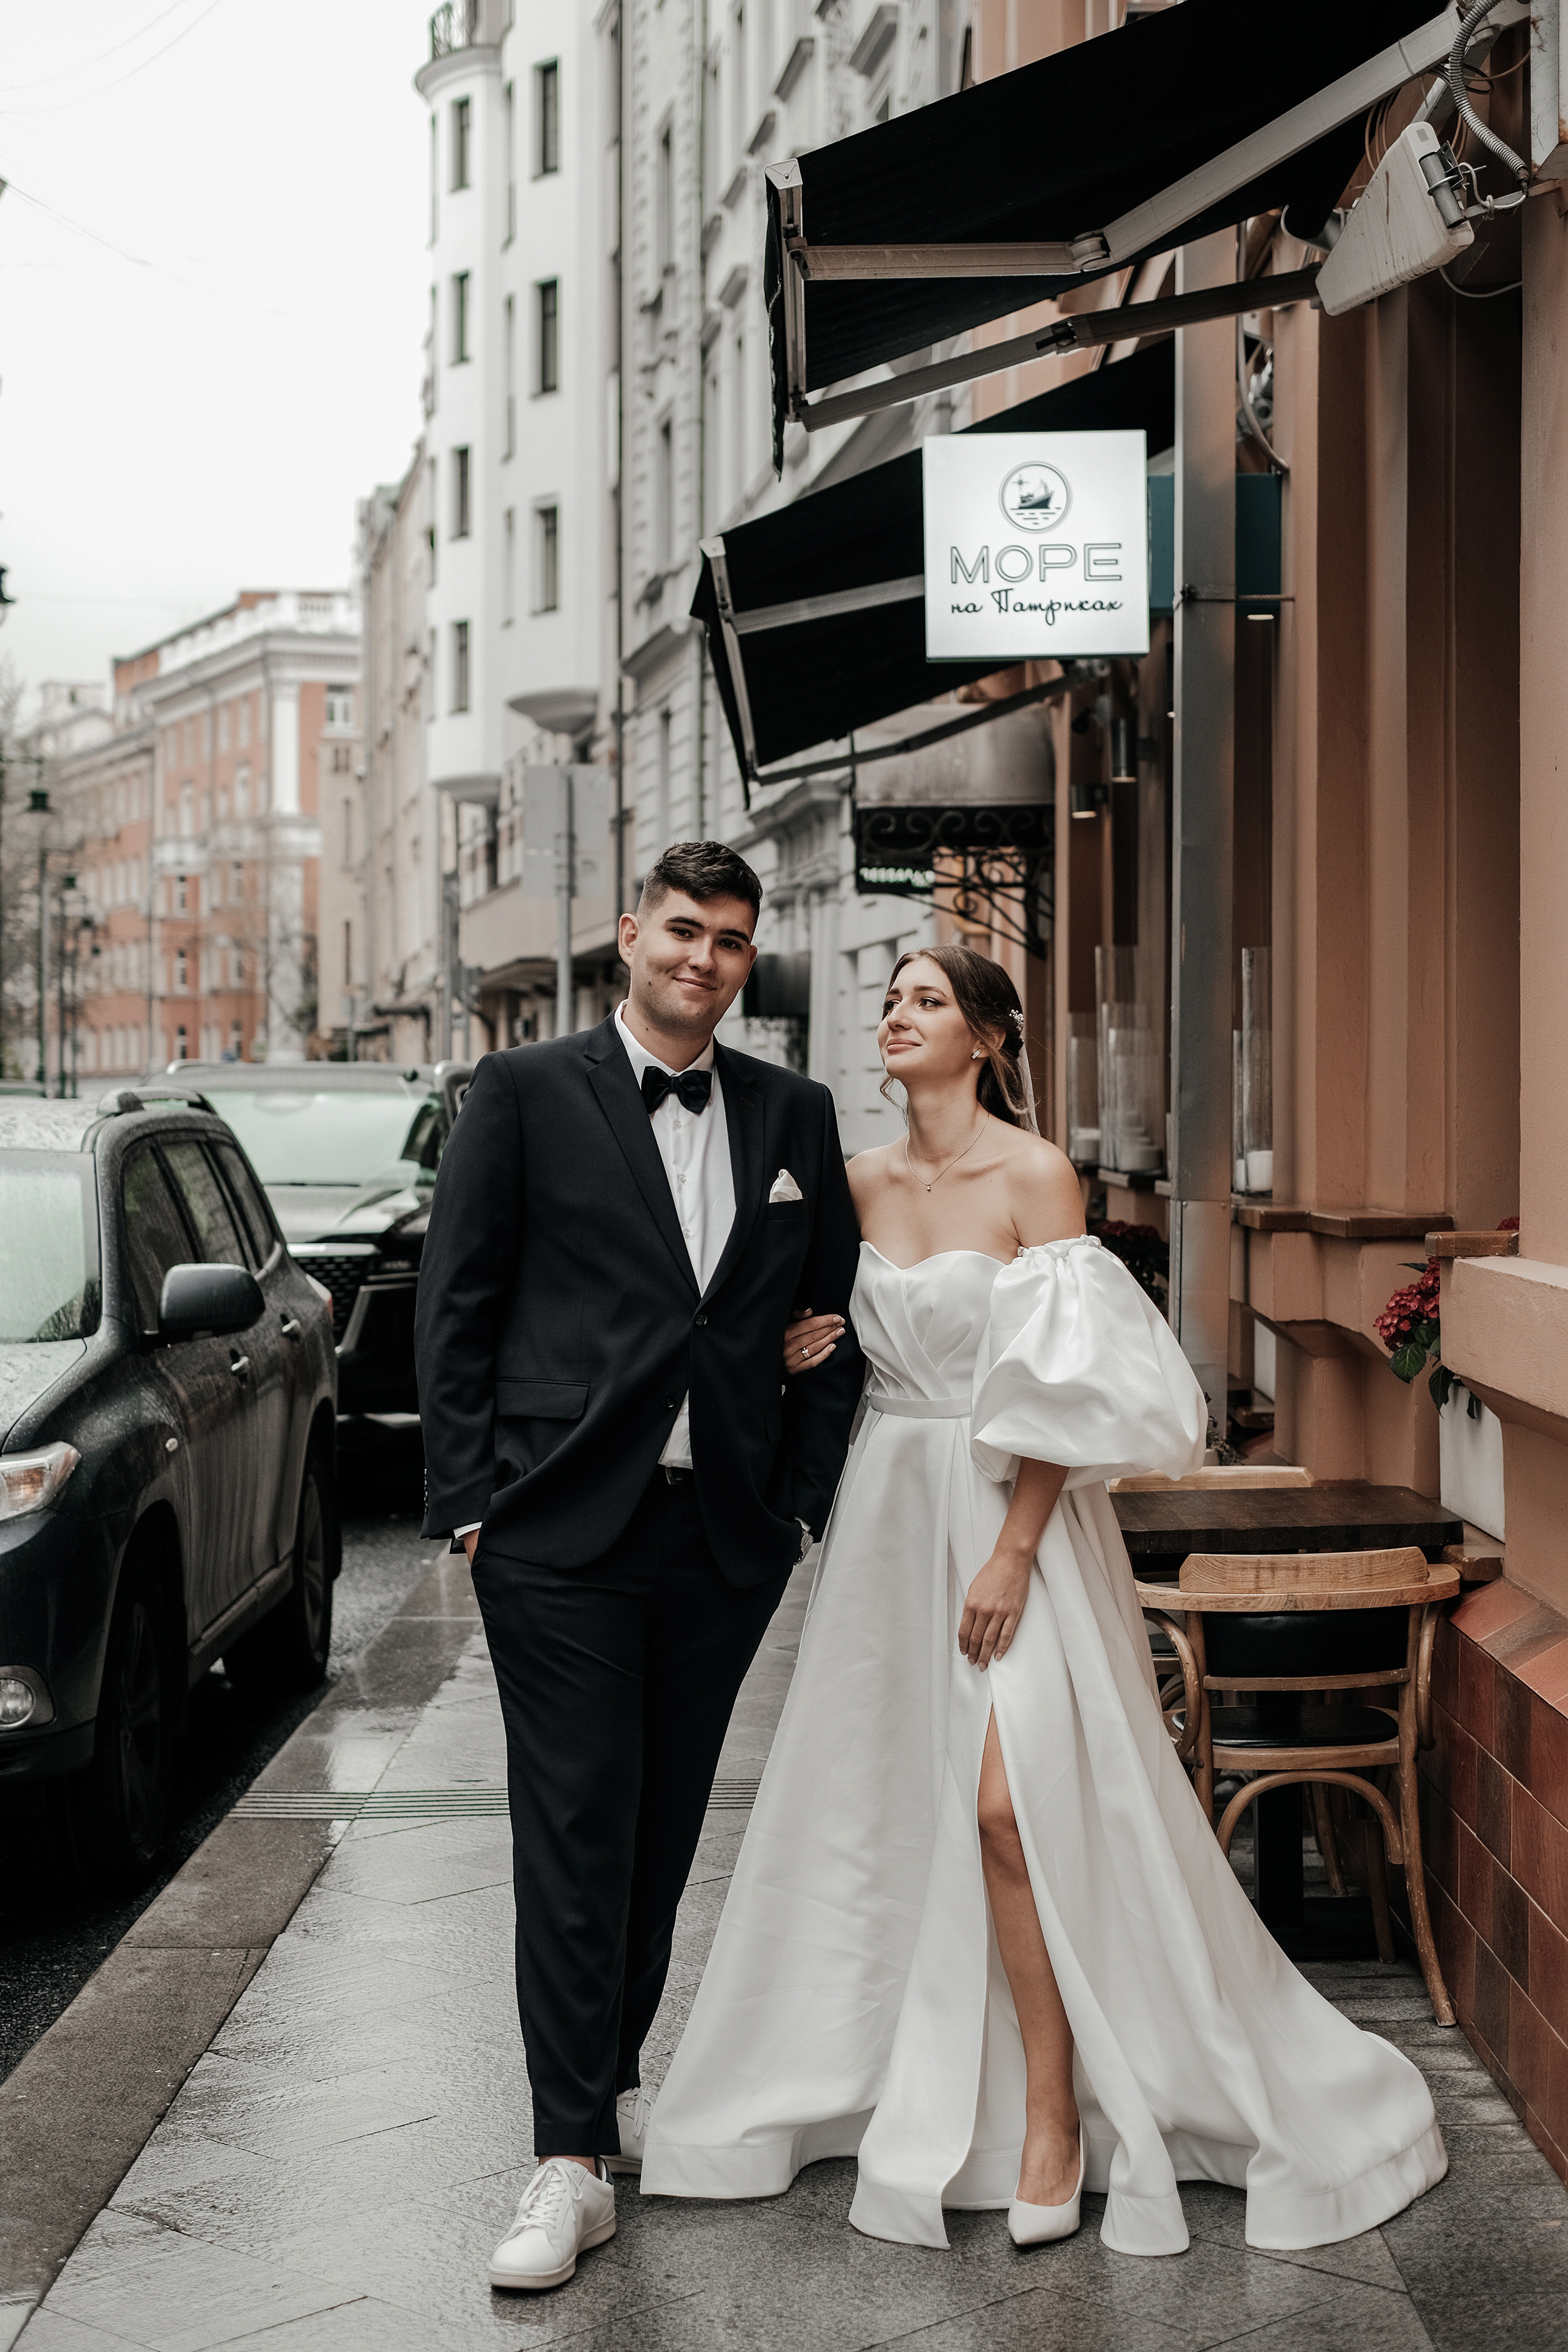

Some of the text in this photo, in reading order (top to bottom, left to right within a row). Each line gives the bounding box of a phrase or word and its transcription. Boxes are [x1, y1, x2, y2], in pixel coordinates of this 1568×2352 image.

[950, 543, 1122, 584] МОРЕ
[951, 588, 1123, 626] на Патриках
